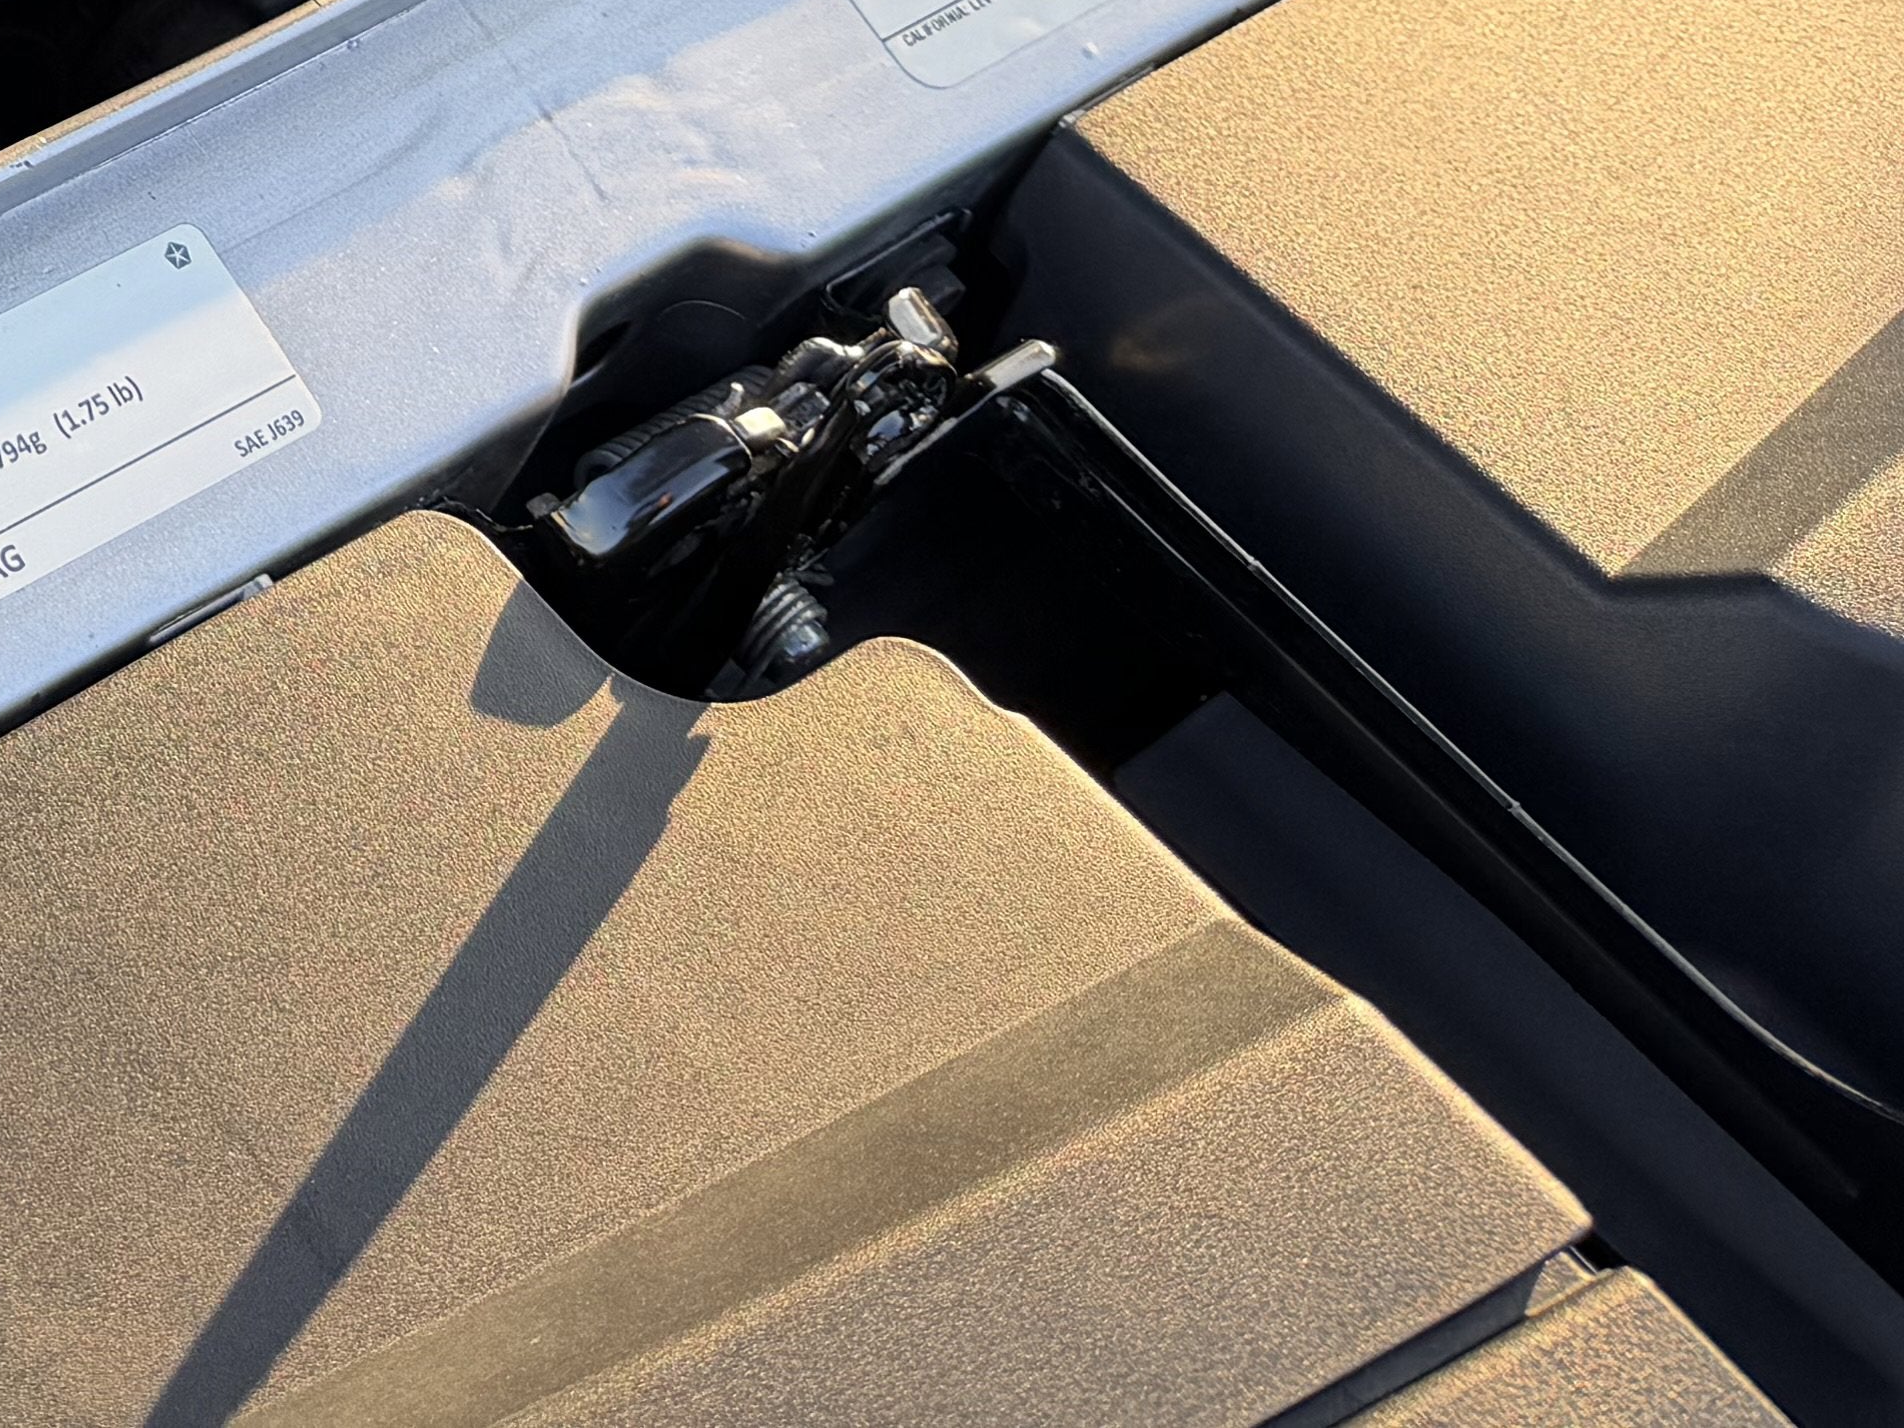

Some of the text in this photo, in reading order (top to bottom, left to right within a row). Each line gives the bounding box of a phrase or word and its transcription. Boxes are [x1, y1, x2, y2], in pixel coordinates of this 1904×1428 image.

[901, 4, 970, 47] CALIFORNIA:
[52, 392, 111, 440] (1.75
[106, 375, 145, 409] lb)
[233, 409, 305, 458] SAE J639
